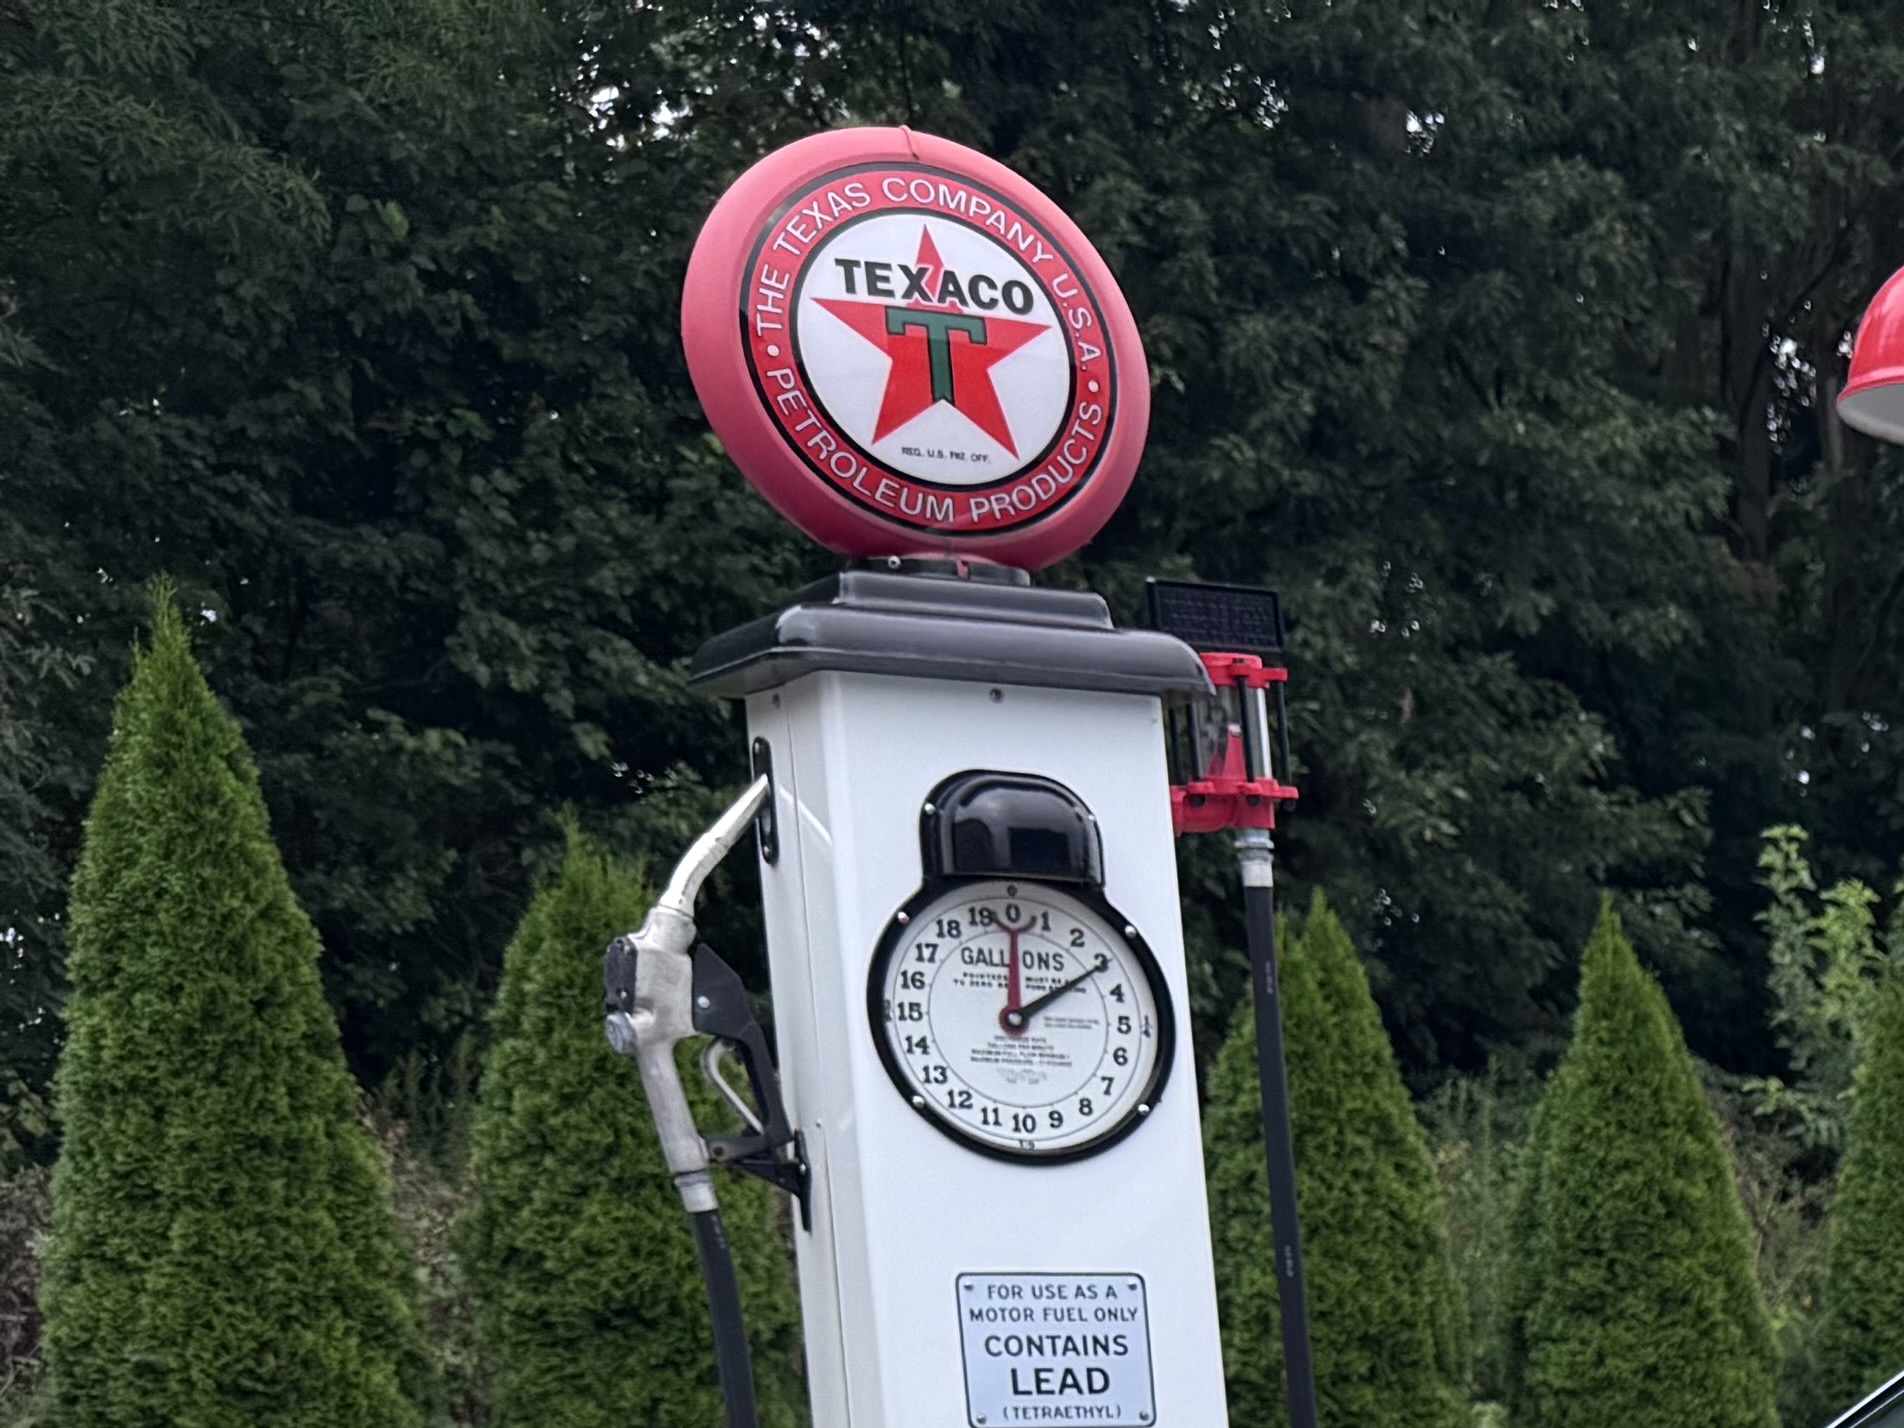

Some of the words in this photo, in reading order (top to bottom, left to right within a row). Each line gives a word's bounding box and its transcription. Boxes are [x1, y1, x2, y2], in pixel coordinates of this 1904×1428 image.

[773, 182, 871, 255] TEXAS
[882, 177, 1054, 264] COMPANY
[834, 258, 1034, 316] TEXACO
[756, 263, 791, 336] THE
[1050, 272, 1101, 372] U.S.A.
[885, 305, 987, 406] T
[766, 367, 954, 523] PETROLEUM
[969, 401, 1102, 523] PRODUCTS
[1005, 903, 1021, 923] 0
[1040, 911, 1052, 932] 1
[935, 918, 962, 939] 18
[1069, 928, 1086, 948] 2
[915, 943, 939, 963] 17
[900, 970, 926, 990] 16
[1110, 984, 1125, 1003] 4
[897, 1002, 923, 1022] 15
[1117, 1016, 1132, 1035] 5
[905, 1035, 930, 1055] 14
[1113, 1046, 1128, 1066] 6
[922, 1065, 948, 1085] 13
[1100, 1076, 1114, 1096] 7
[947, 1090, 973, 1110] 12
[1078, 1098, 1093, 1117] 8
[981, 1106, 1002, 1127] 11
[1012, 1113, 1037, 1134] 10
[1048, 1110, 1063, 1129] 9
[987, 1284, 1024, 1300] FOR
[1031, 1284, 1068, 1300] USE
[1074, 1284, 1099, 1300] AS
[1105, 1284, 1119, 1300] A
[969, 1306, 1035, 1322] MOTOR
[1043, 1306, 1088, 1322] FUEL
[1093, 1306, 1138, 1322] ONLY
[984, 1334, 1129, 1357] CONTAINS
[1010, 1367, 1111, 1396] LEAD
